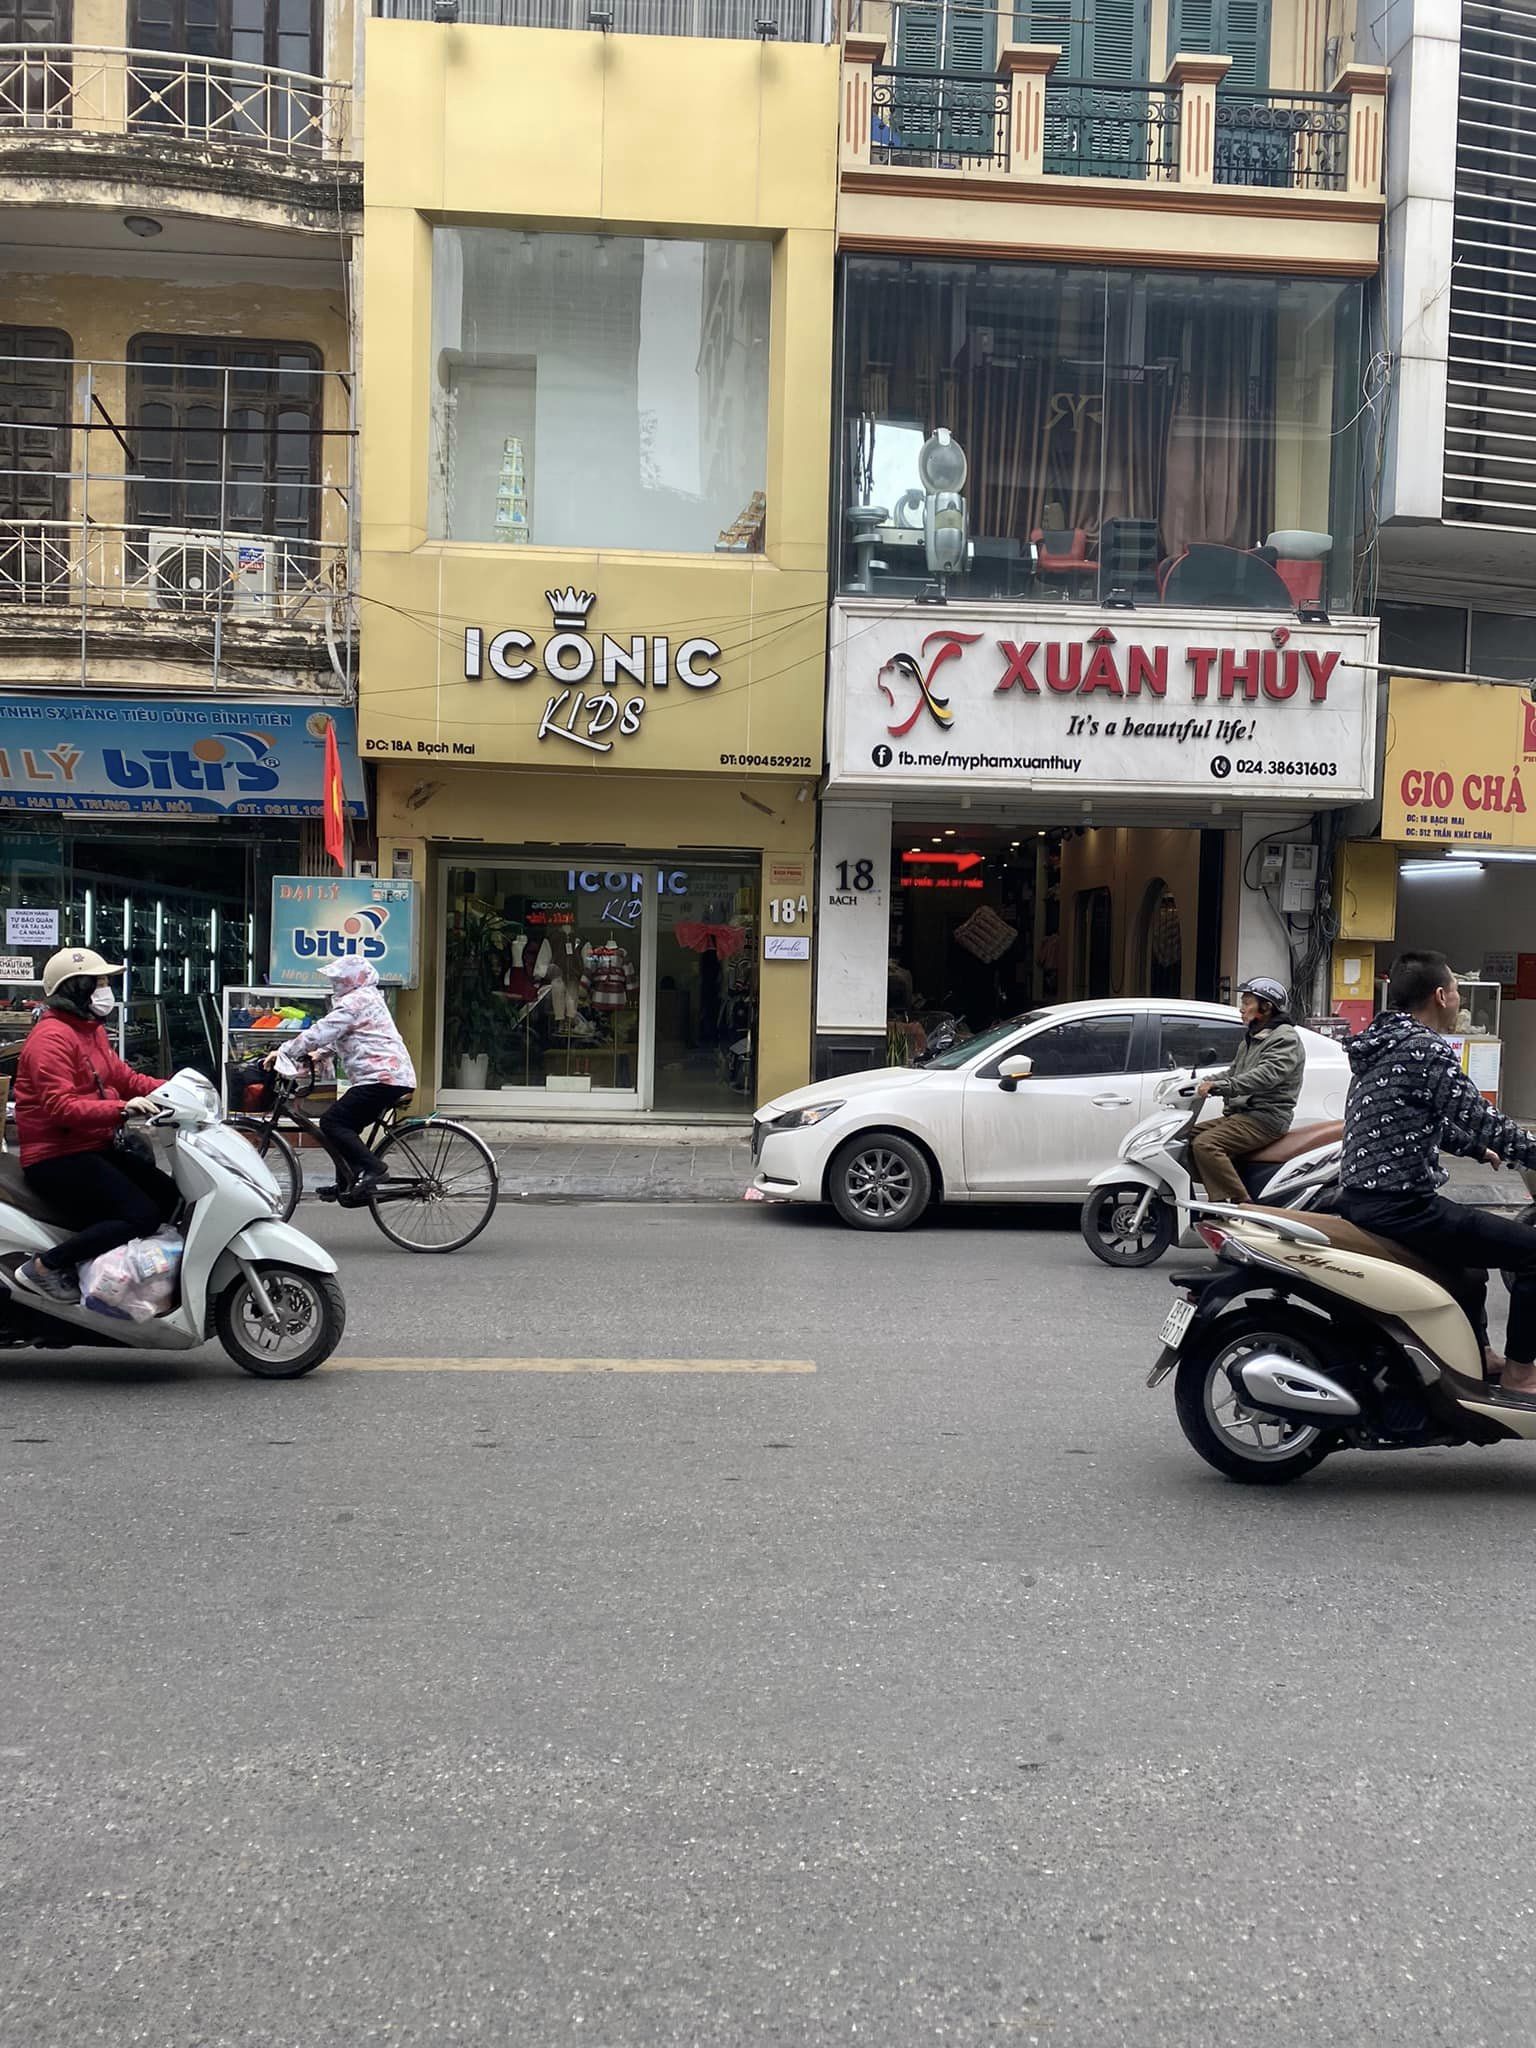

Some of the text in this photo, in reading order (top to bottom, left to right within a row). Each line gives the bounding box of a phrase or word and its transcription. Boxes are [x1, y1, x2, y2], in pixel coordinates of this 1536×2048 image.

[465, 627, 722, 689] ICONIC
[994, 626, 1341, 701] XUÂN THỦY
[72, 706, 117, 720] HÀNG
[121, 707, 158, 722] TIÊU
[163, 708, 208, 724] DÙNG
[212, 710, 251, 725] BÌNH
[254, 711, 292, 726] TIÊN
[538, 688, 646, 752] KIDS
[1066, 715, 1256, 744] It's a beautiful life!
[366, 739, 388, 750] ĐC:
[391, 740, 412, 751] 18A
[417, 741, 449, 755] Bạch
[720, 754, 812, 767] ĐT: 0904529212
[21, 743, 85, 781] LÝ
[899, 751, 1081, 772] fb.me/myphamxuanthuy
[1236, 759, 1337, 776] 024.38631603
[1463, 765, 1527, 813] CHẢ
[27, 797, 53, 808] HAI
[142, 799, 163, 812] HÀ
[835, 859, 874, 891] 18
[318, 882, 339, 901] LÝ
[601, 898, 642, 928] KID
[769, 895, 808, 923] 18A
